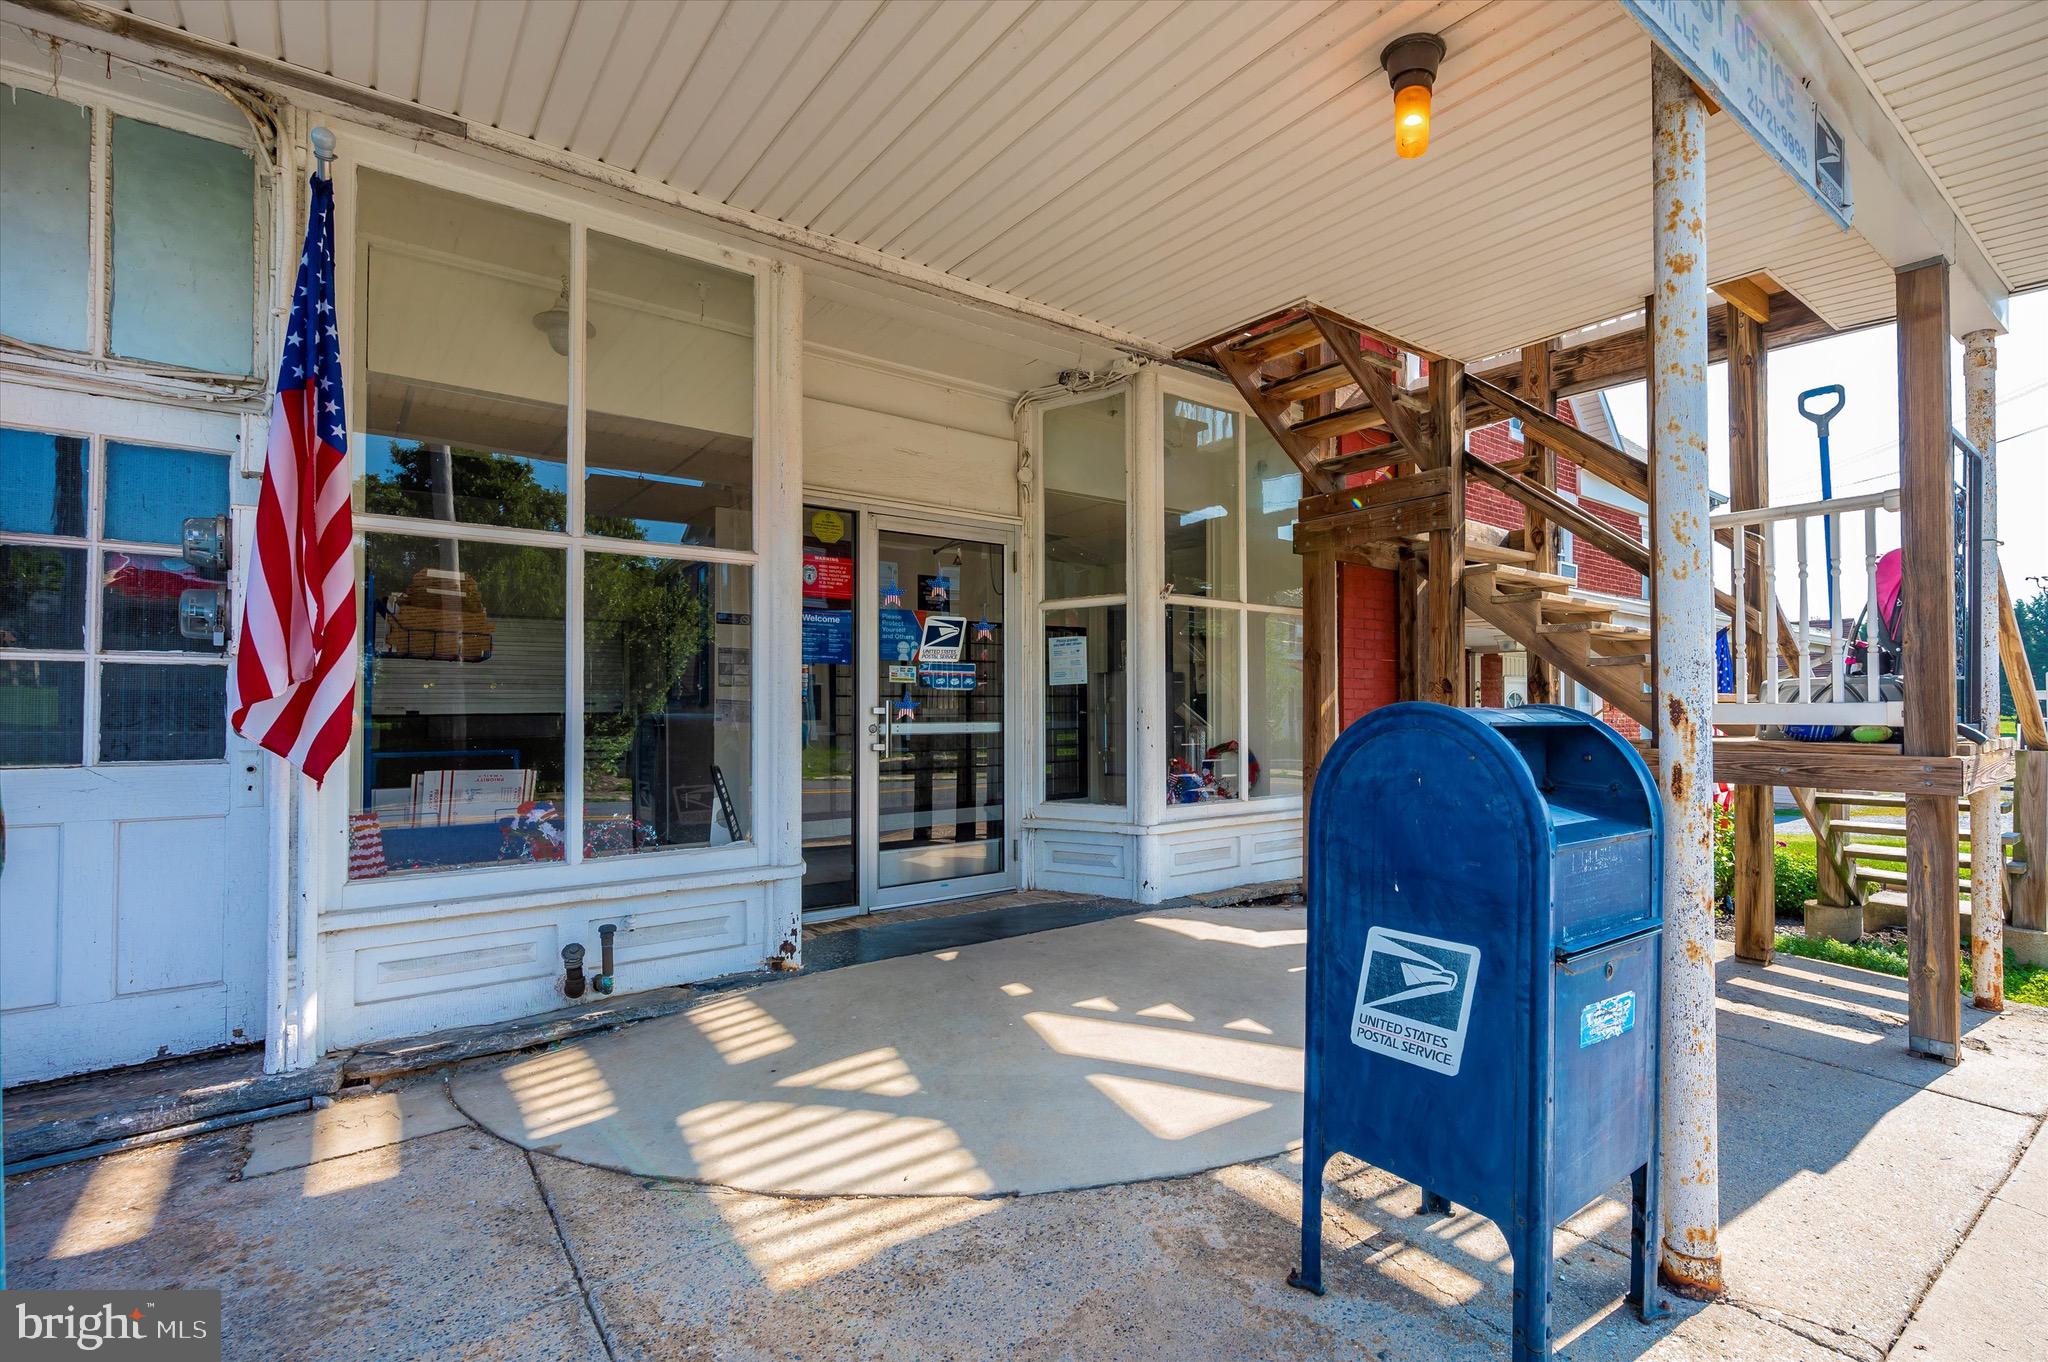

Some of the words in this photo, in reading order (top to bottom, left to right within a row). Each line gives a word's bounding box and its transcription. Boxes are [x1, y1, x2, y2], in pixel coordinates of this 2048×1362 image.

[1651, 0, 1700, 52] VILLE
[1712, 46, 1730, 84] MD
[1735, 14, 1797, 123] OFFICE
[802, 613, 840, 624] Welcome
[1357, 1027, 1399, 1050] POSTAL
[1401, 1041, 1453, 1066] SERVICE
[1359, 1013, 1403, 1035] UNITED
[1404, 1026, 1448, 1049] STATES
